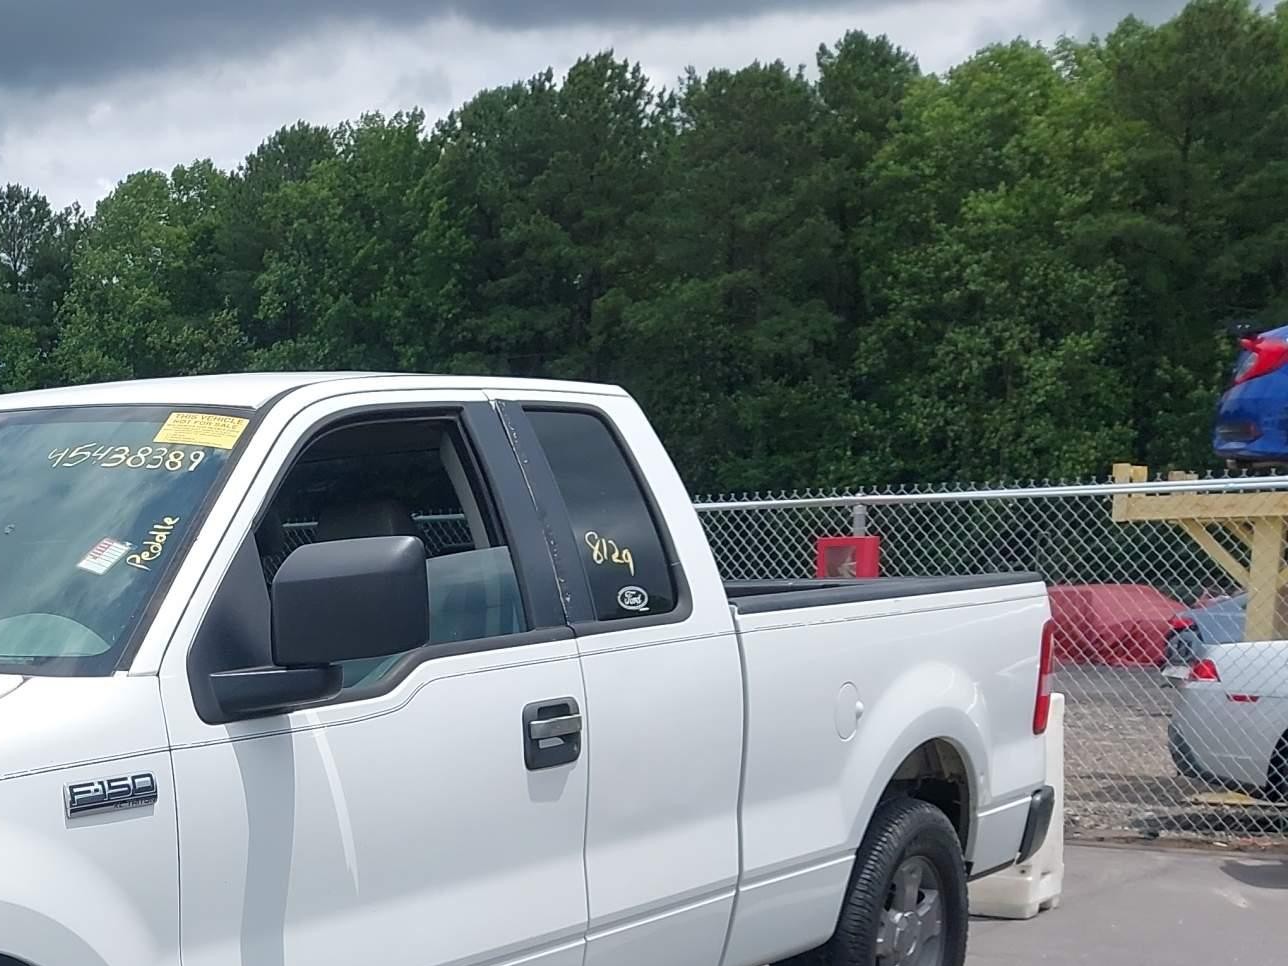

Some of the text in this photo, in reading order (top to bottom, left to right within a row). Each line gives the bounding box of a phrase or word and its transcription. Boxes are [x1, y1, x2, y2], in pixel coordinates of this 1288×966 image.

[201, 415, 244, 426] VEHICLE
[214, 422, 239, 430] SALE
[47, 442, 205, 472] 45438389
[126, 516, 180, 571] Peddle
[584, 531, 635, 577] 8129
